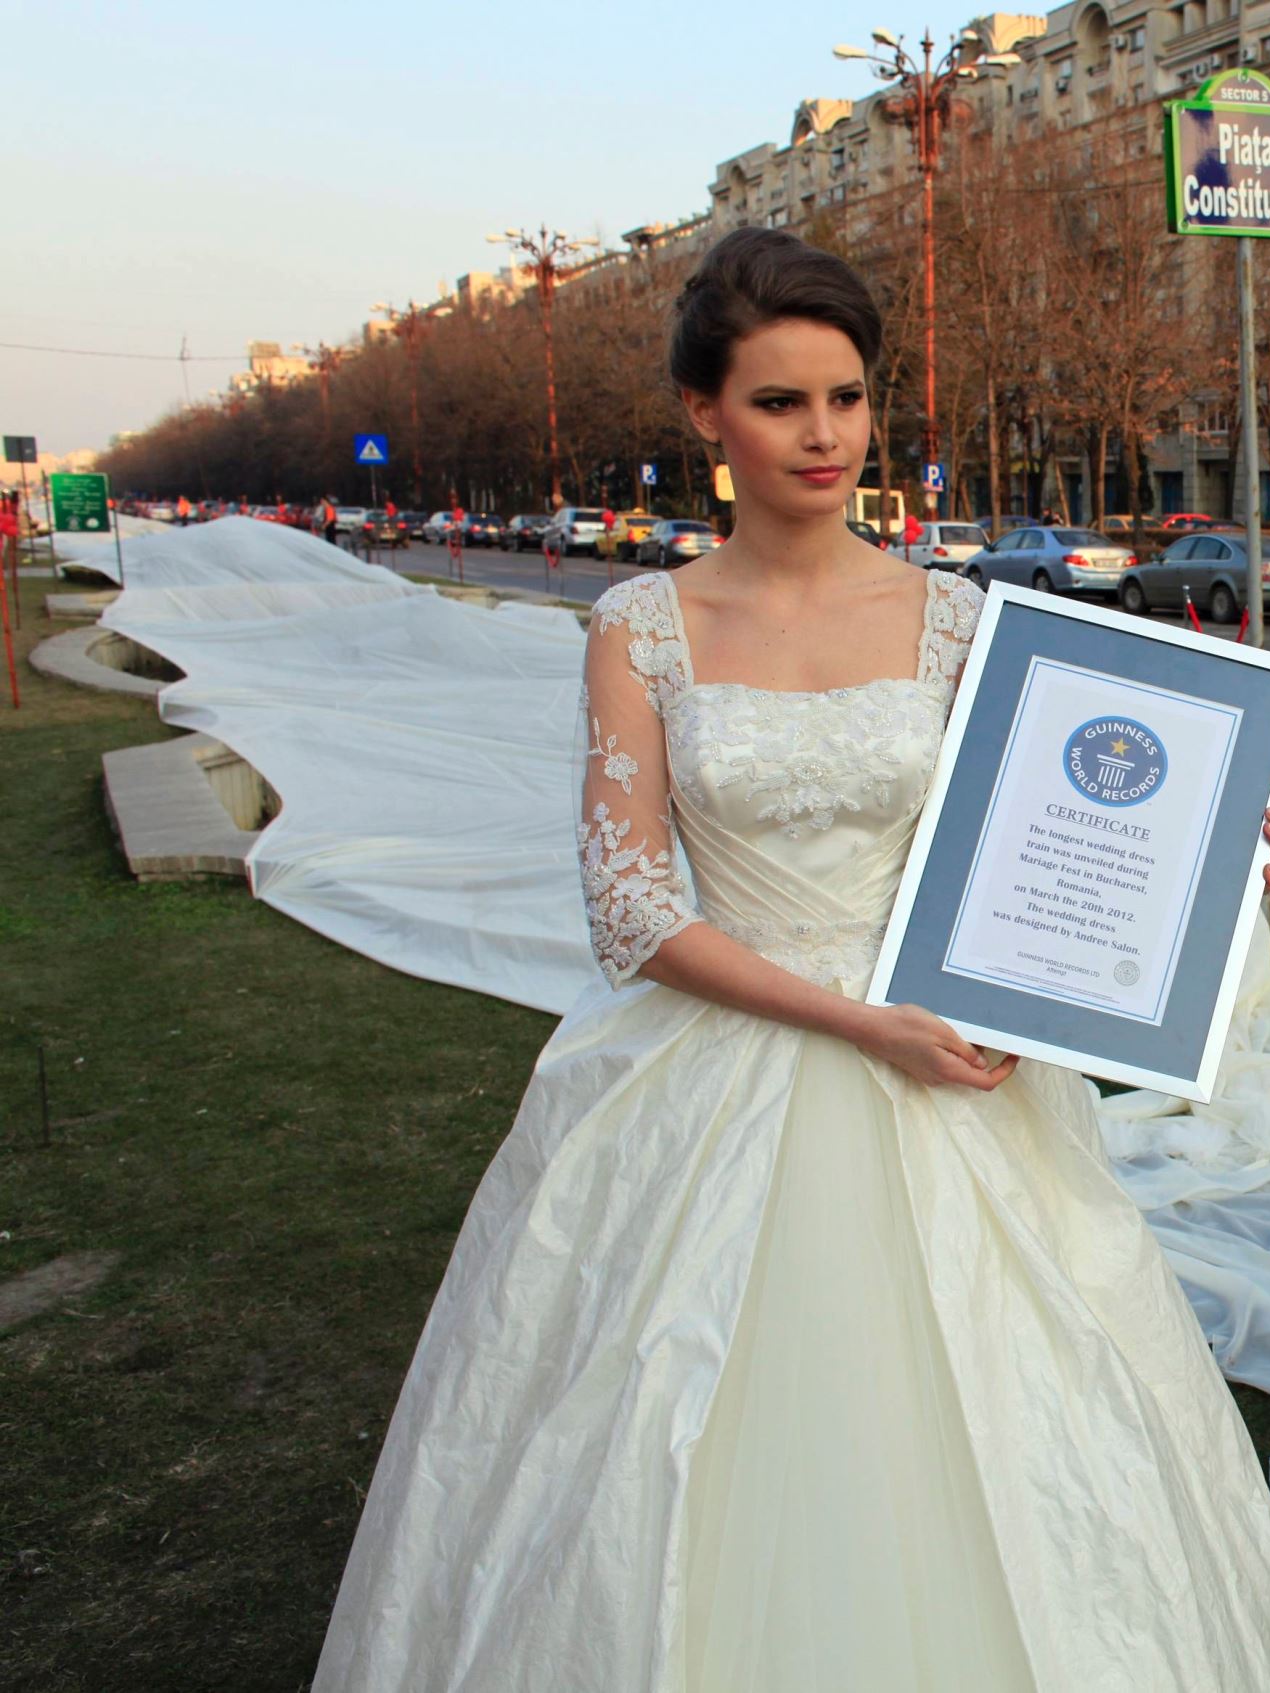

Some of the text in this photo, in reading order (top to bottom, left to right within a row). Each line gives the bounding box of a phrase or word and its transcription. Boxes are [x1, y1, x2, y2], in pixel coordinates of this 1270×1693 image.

[1221, 87, 1269, 102] SECTOR 5
[1085, 722, 1158, 756] GUINNESS
[1071, 747, 1160, 800] WORLD RECORDS
[1046, 803, 1151, 841] CERTIFICATE
[1026, 840, 1150, 880] train was unveiled during
[1029, 824, 1156, 865] The longest wedding dress
[1019, 853, 1148, 895] Mariage Fest in Bucharest,
[1014, 884, 1136, 923] on March the 20th 2012.
[1026, 902, 1116, 933] The wedding dress
[992, 910, 1141, 956] was designed by Andree Salon.
[1017, 950, 1044, 963] GUINNESS
[1045, 957, 1064, 968] WORLD
[1064, 962, 1090, 975] RECORDS
[1090, 968, 1100, 978] LTD
